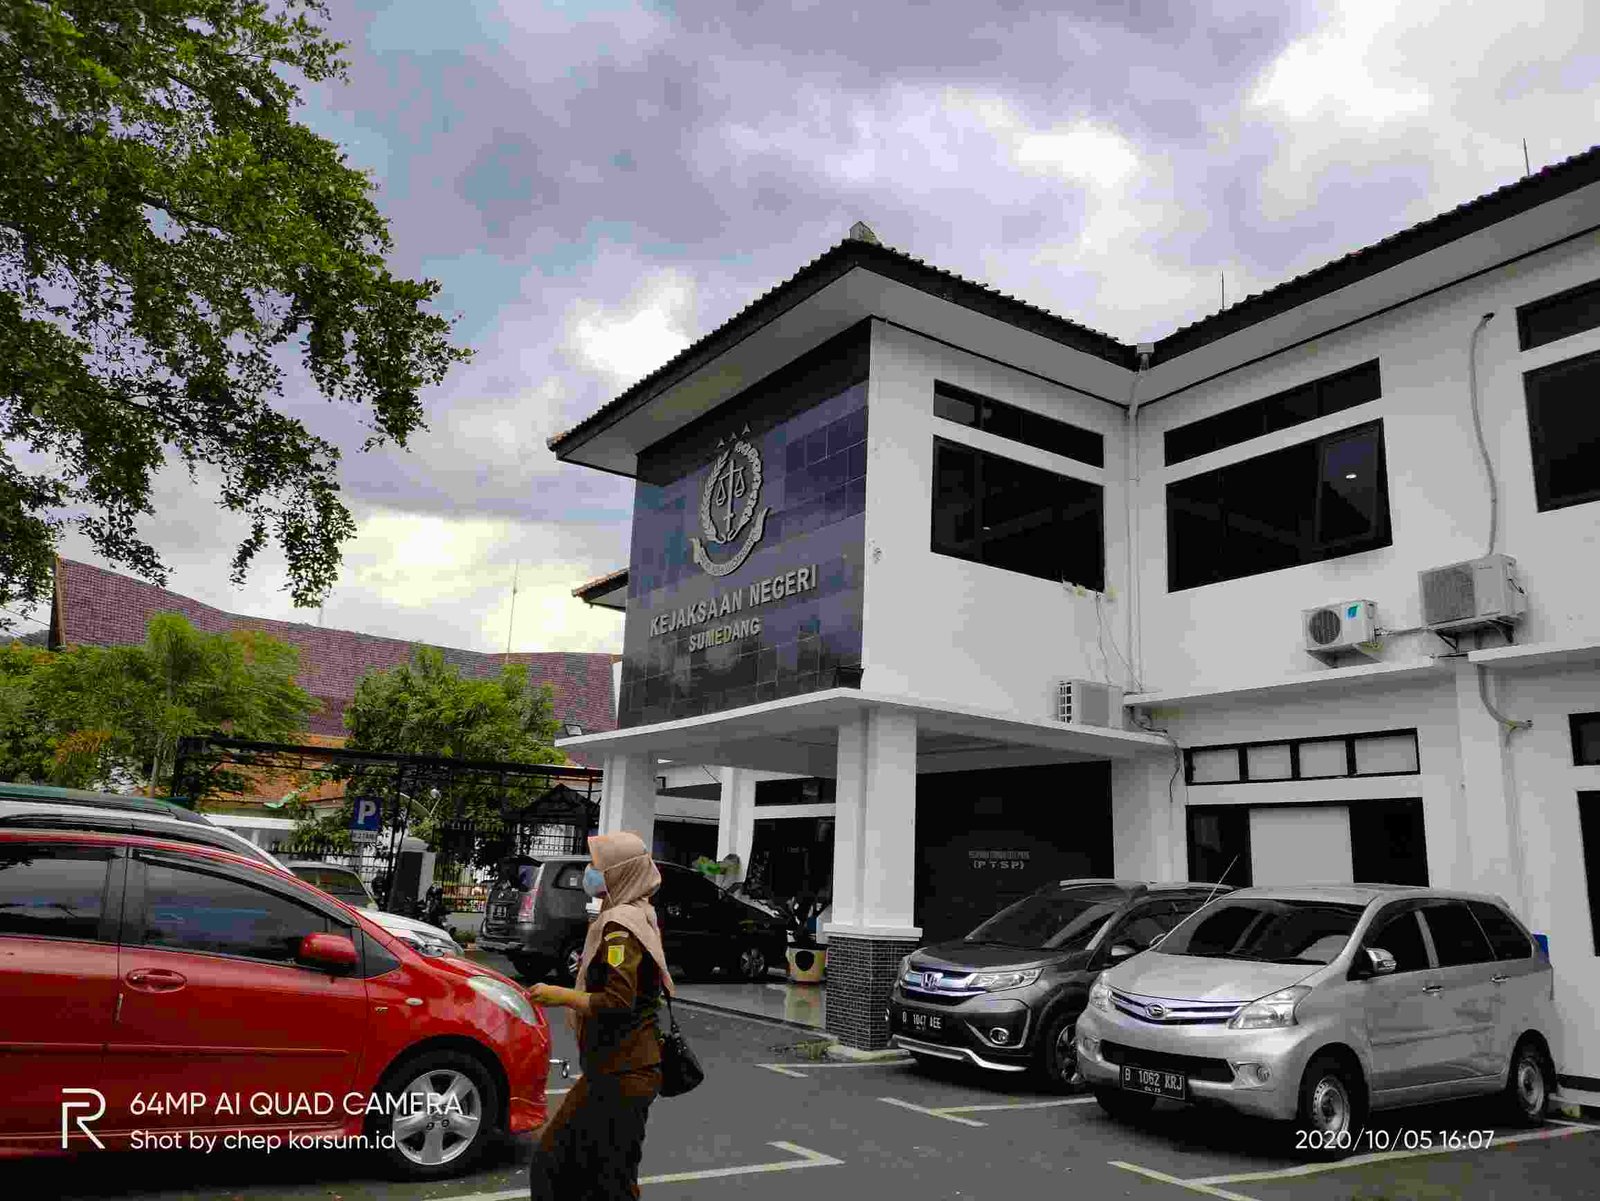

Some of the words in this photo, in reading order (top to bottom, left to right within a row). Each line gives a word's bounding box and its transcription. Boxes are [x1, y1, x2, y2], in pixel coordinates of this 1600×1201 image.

[650, 588, 743, 637] KEJAKSAAN
[749, 564, 818, 608] NEGERI
[688, 617, 761, 653] SUMEDANG
[357, 799, 377, 825] P
[1124, 1067, 1131, 1081] B
[1139, 1070, 1161, 1087] 1062
